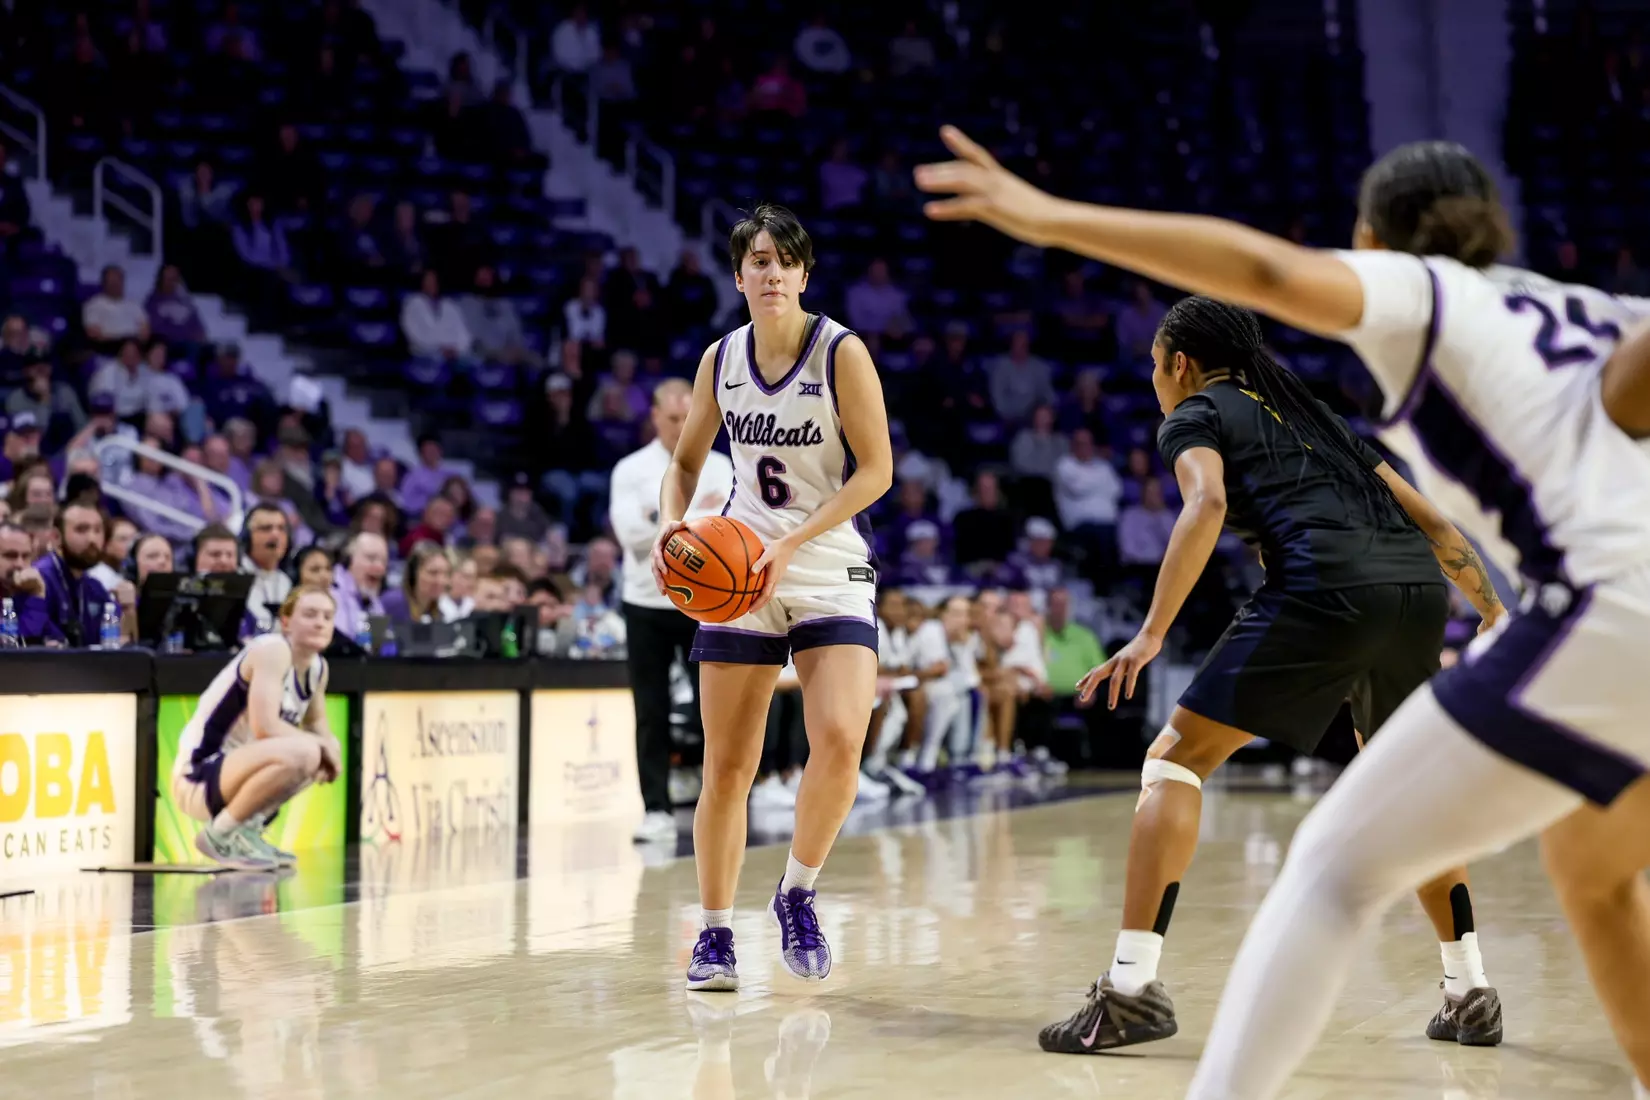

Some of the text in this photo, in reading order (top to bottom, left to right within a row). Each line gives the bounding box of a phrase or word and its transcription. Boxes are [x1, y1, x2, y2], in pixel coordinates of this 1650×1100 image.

[726, 410, 824, 446] Wildcats
[757, 455, 792, 510] 6
[665, 538, 706, 574] ELITE
[4, 825, 112, 859] CAN EATS
